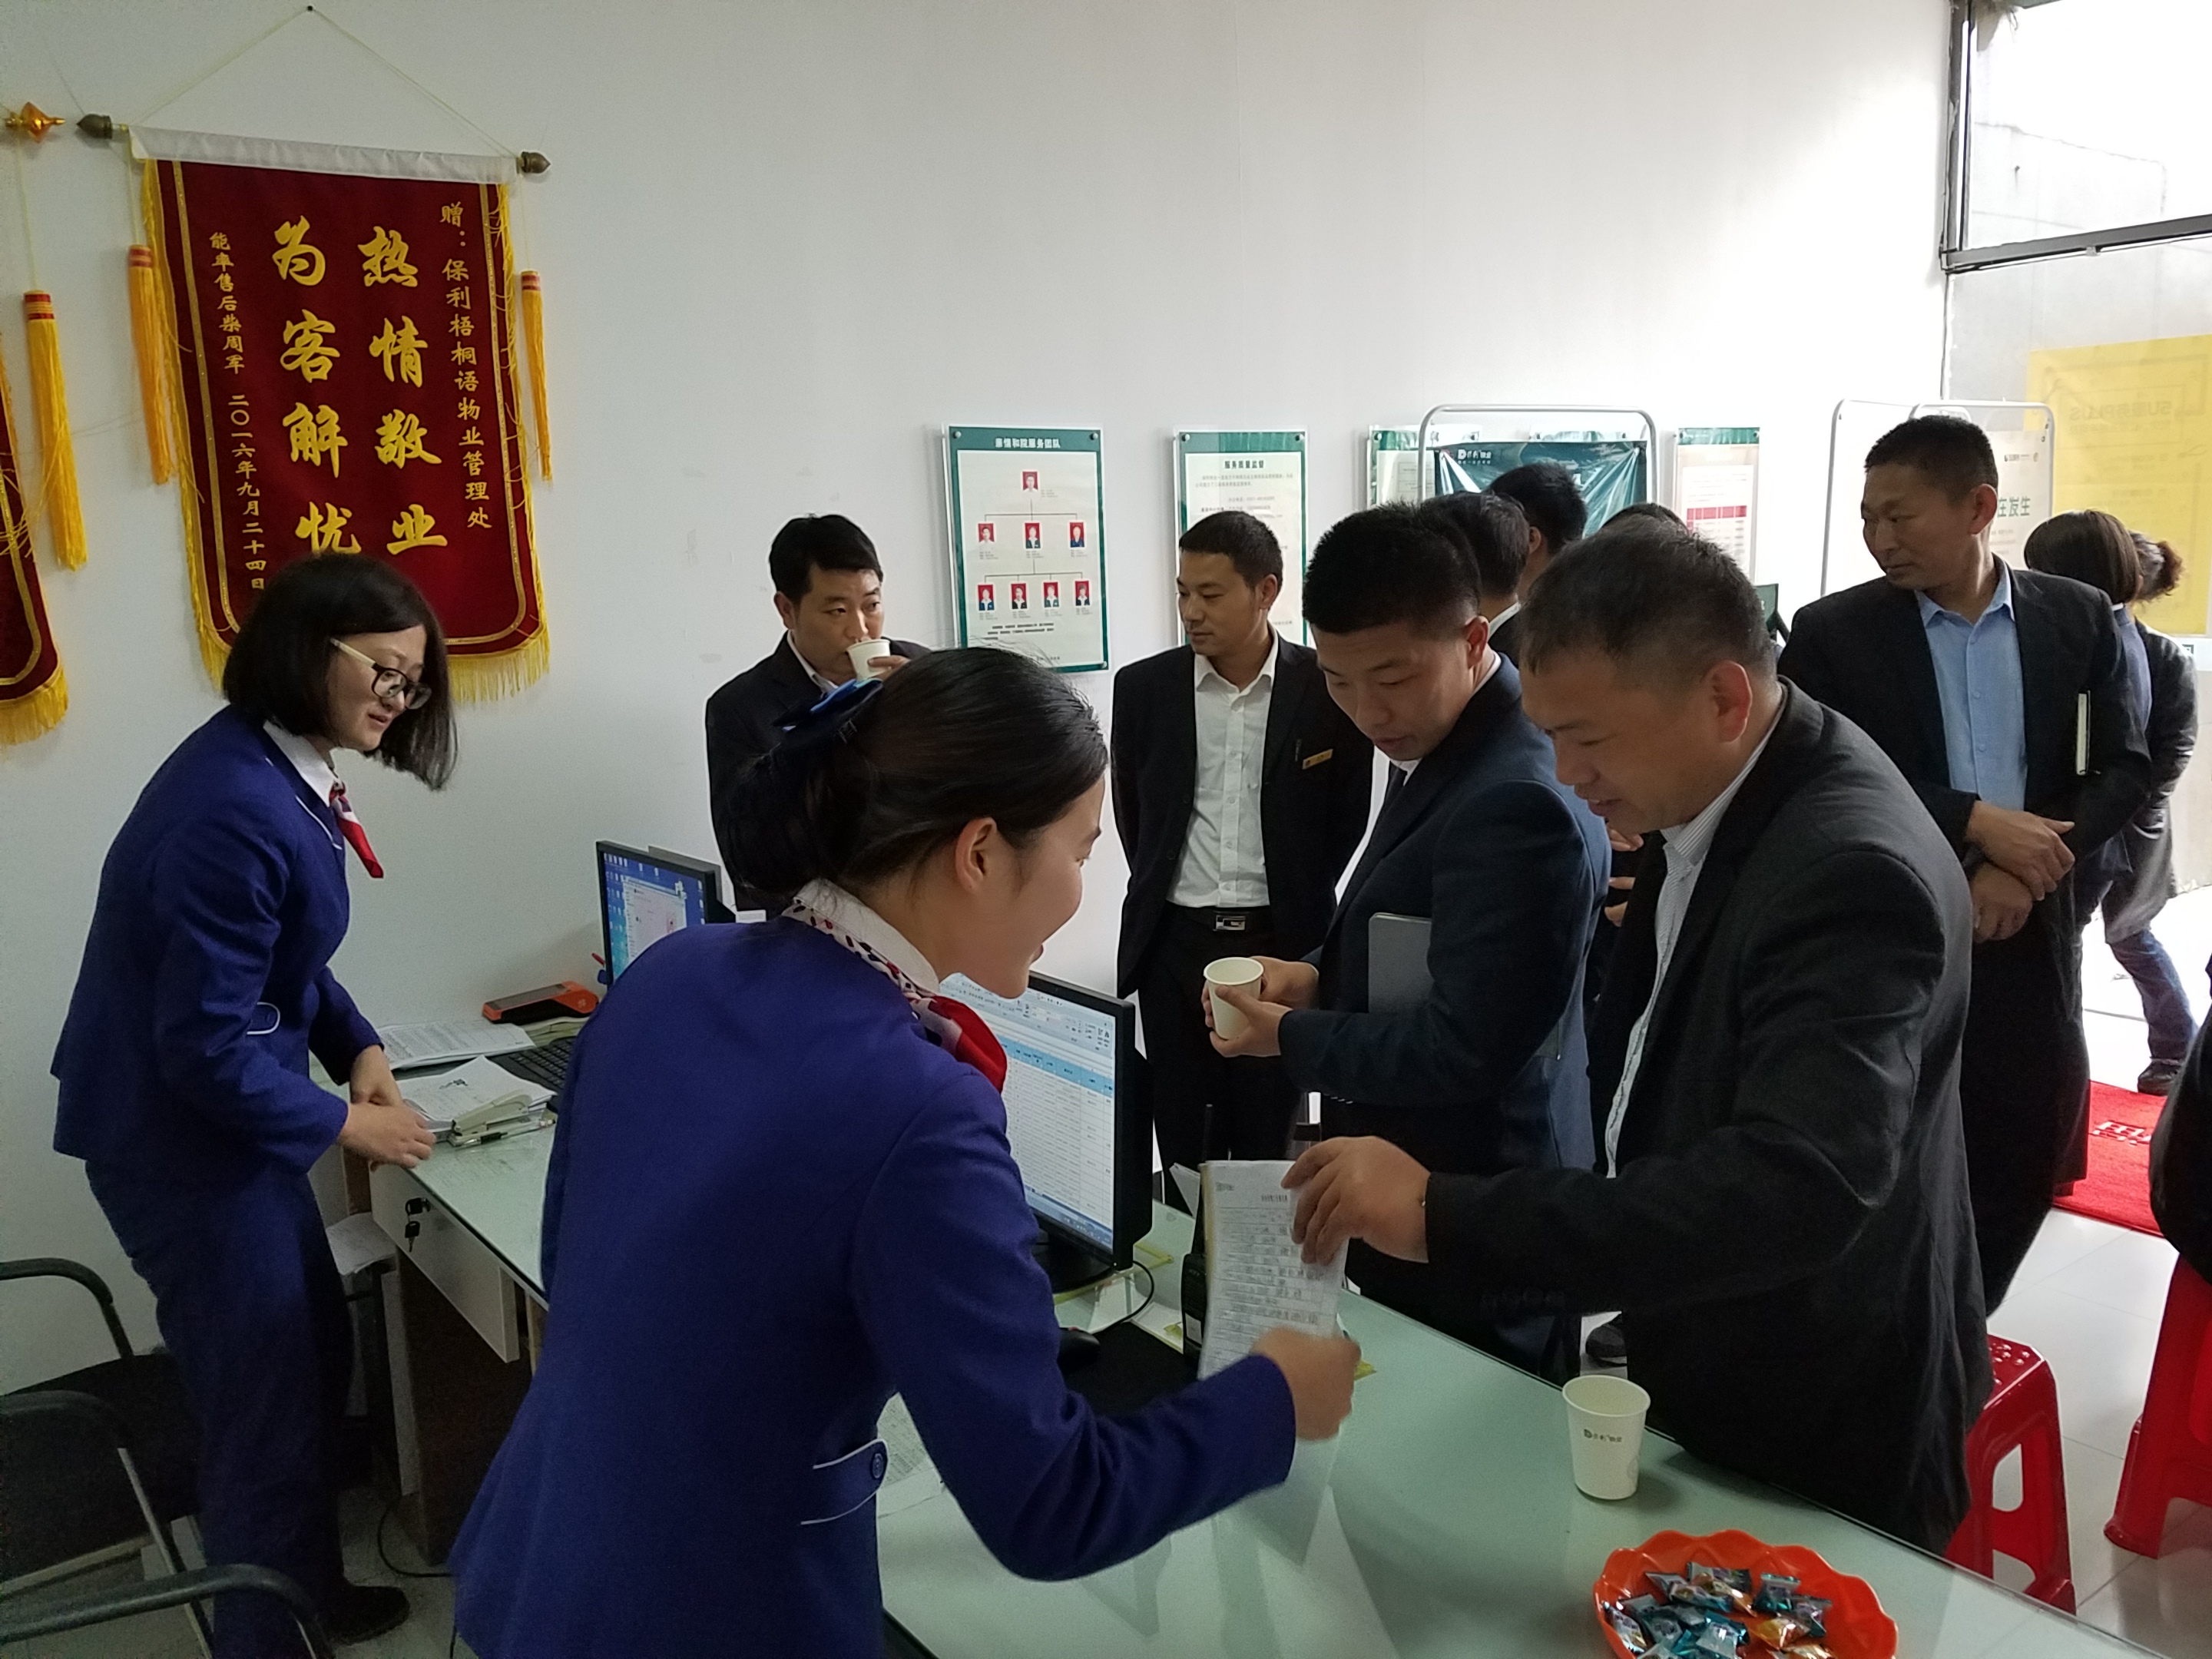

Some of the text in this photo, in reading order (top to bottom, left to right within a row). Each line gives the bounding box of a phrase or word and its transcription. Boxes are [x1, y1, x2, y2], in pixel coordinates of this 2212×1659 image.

[272, 215, 363, 557] 为客解忧
[357, 226, 448, 555] 热情敬业
[1224, 460, 1264, 469] 服务质量监督
